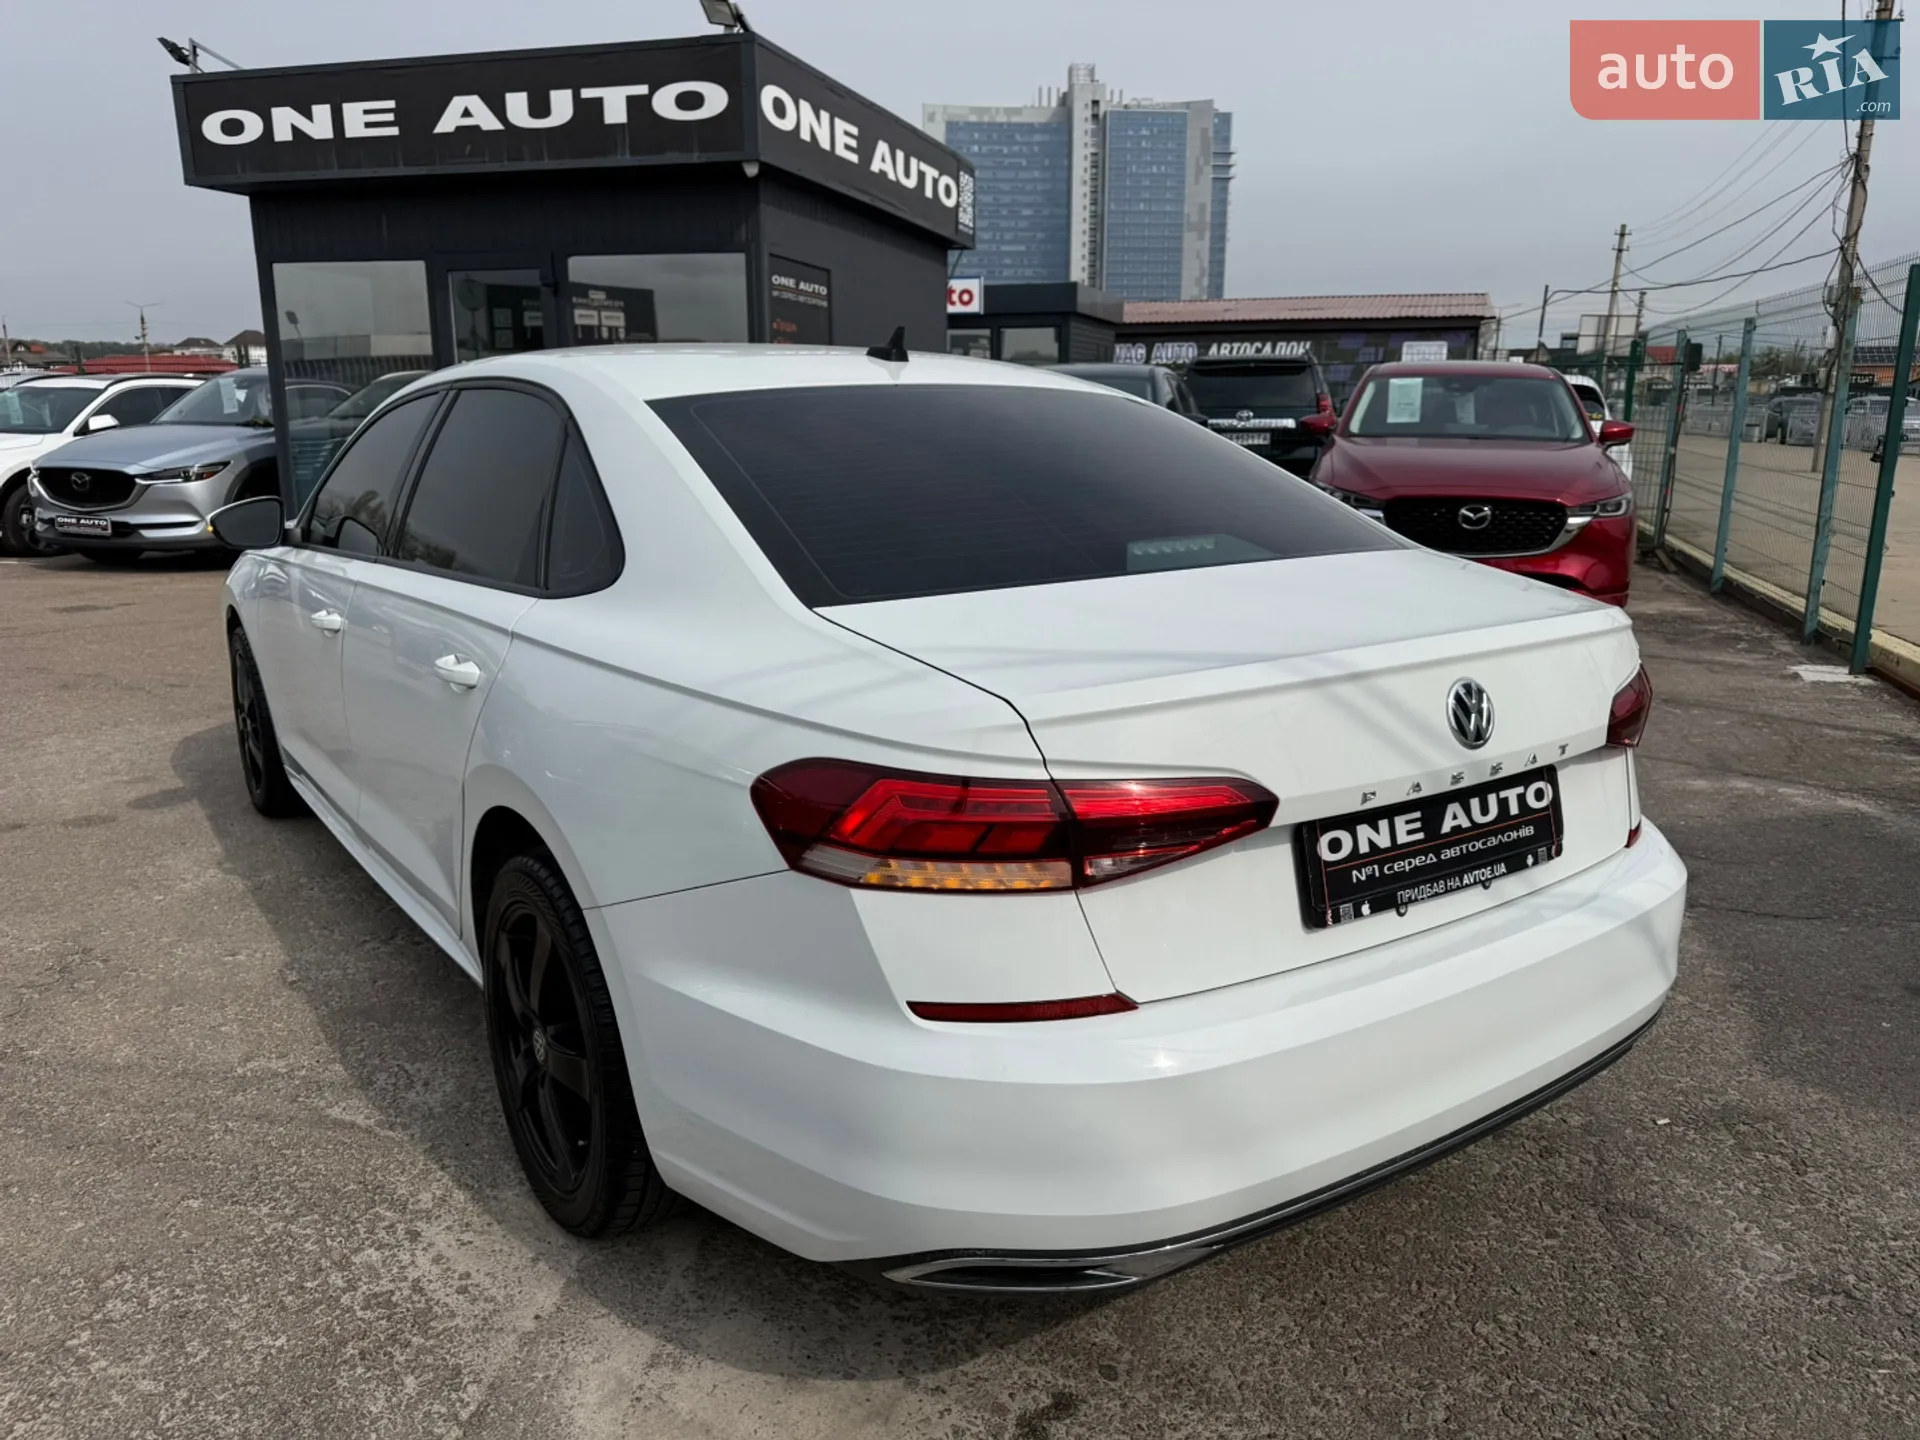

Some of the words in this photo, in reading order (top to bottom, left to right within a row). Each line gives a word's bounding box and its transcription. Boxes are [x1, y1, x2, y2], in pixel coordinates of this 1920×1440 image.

[201, 99, 400, 147] ONE
[433, 81, 729, 134] AUTO
[760, 84, 859, 164] ONE
[870, 139, 958, 208] AUTO
[771, 274, 797, 288] ONE
[798, 281, 828, 295] AUTO
[1150, 342, 1198, 364] AUTO
[1360, 743, 1569, 805] PASSAT
[1317, 810, 1425, 862] ONE
[1440, 781, 1554, 834] AUTO
[1351, 861, 1381, 884] №1
[1383, 852, 1437, 875] серед
[1440, 824, 1535, 858] автосалонів
[1396, 878, 1446, 905] ПРИДБАВ
[1446, 875, 1462, 892] НА
[1461, 862, 1508, 885] AVTOE.UA
